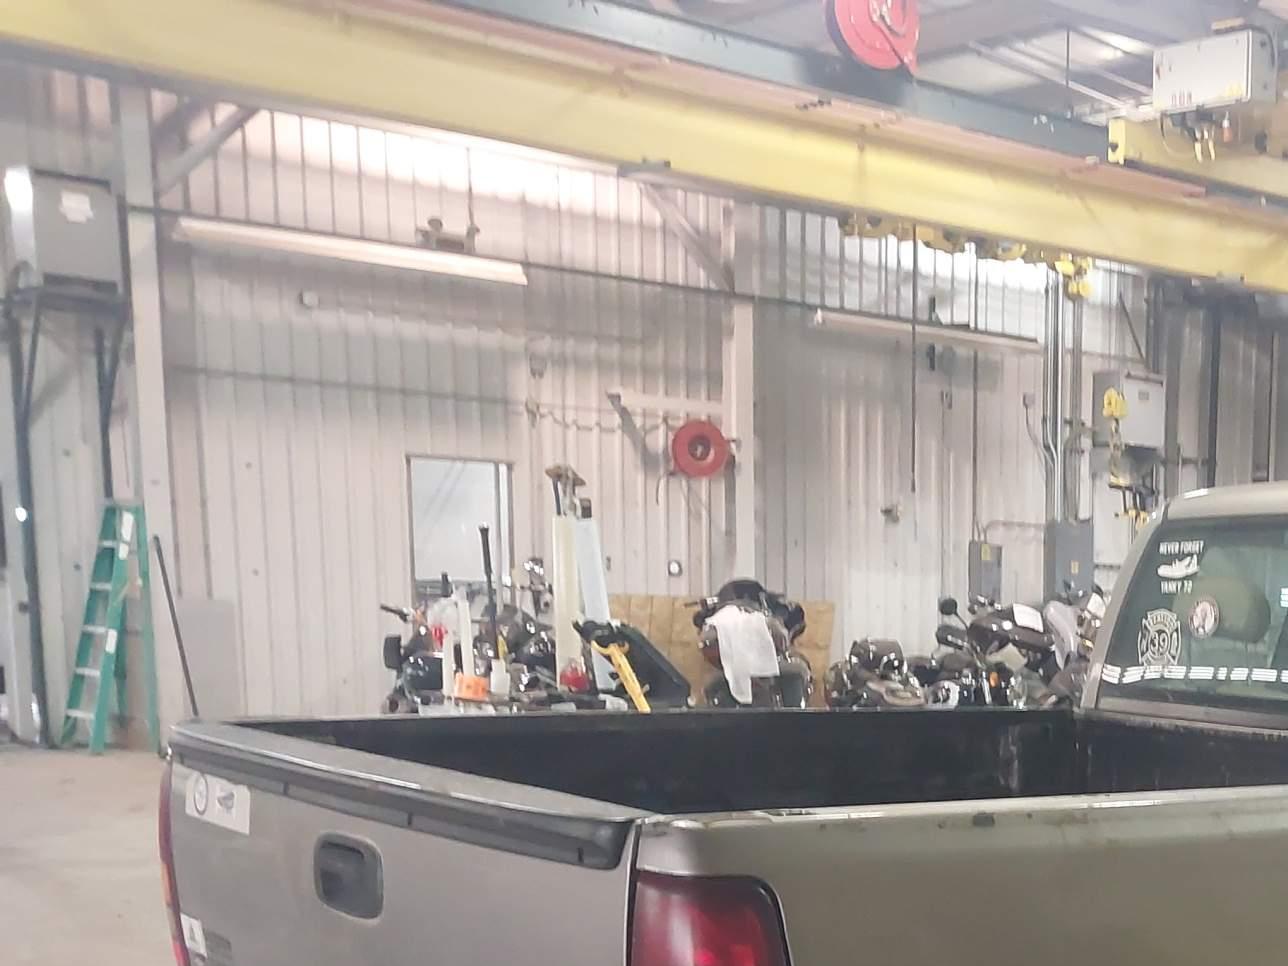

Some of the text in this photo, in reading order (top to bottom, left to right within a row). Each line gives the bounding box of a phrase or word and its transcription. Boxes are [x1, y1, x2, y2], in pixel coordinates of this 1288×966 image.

[1159, 540, 1204, 555] NEVER FORGET
[1150, 631, 1168, 657] 39
